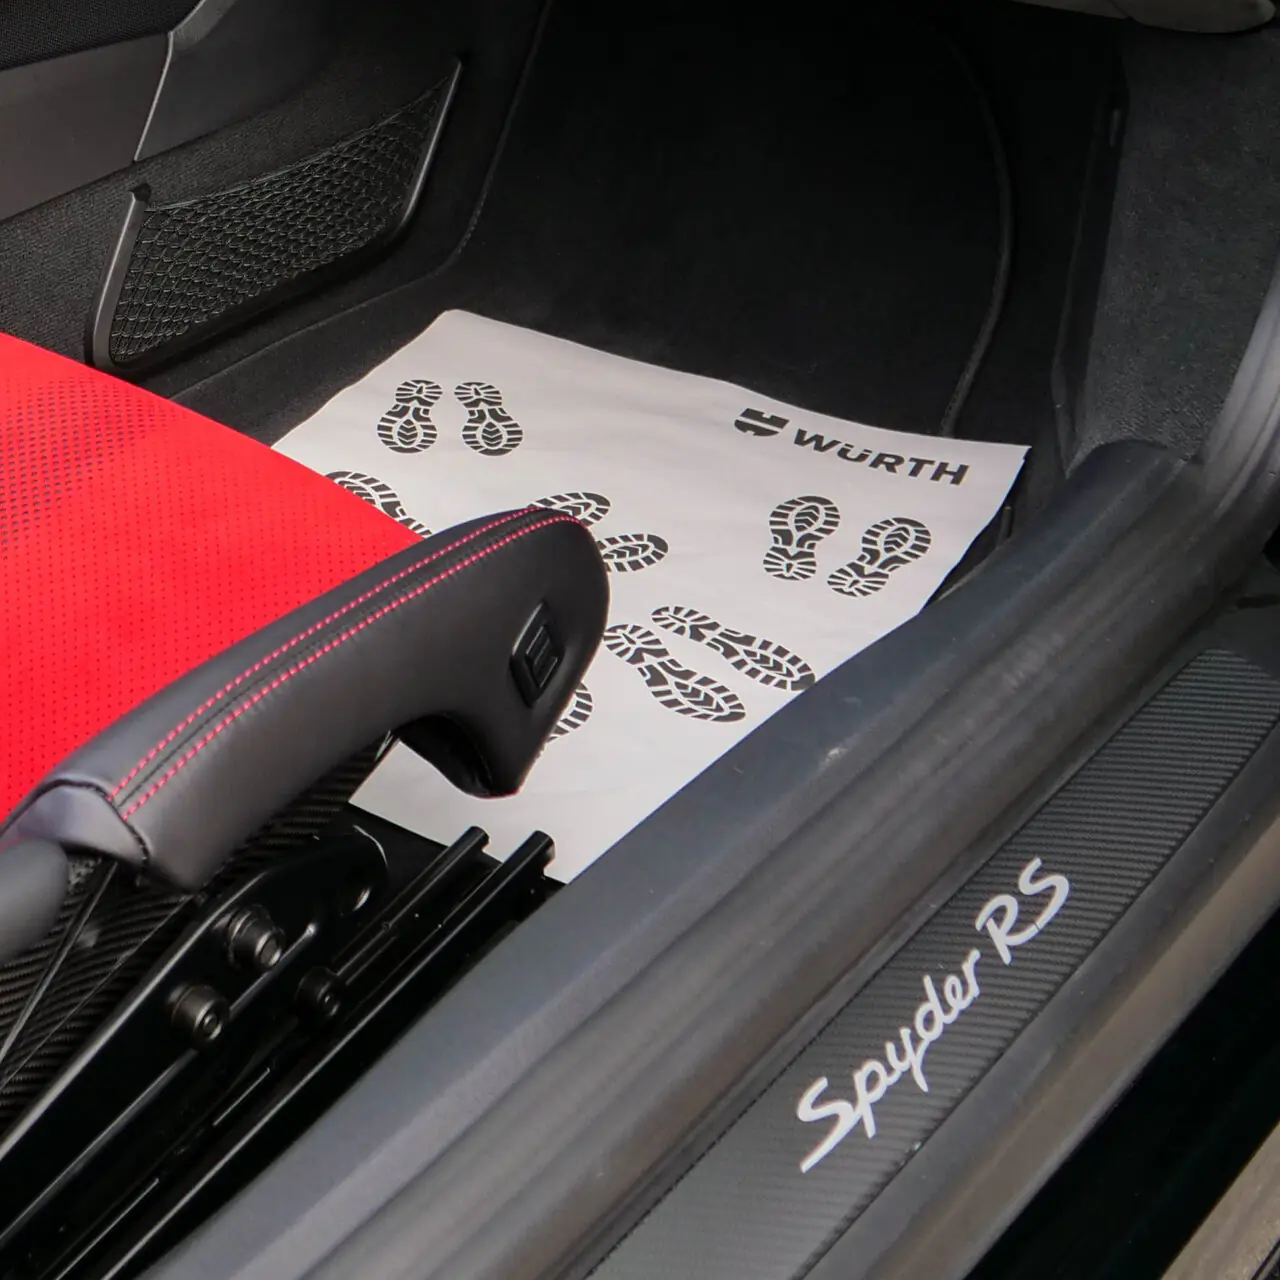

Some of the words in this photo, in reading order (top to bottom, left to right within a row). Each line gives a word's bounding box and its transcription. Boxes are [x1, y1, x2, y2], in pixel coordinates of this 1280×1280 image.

[793, 427, 970, 486] WÜRTH
[796, 948, 981, 1174] Spyder
[975, 856, 1071, 965] RS
